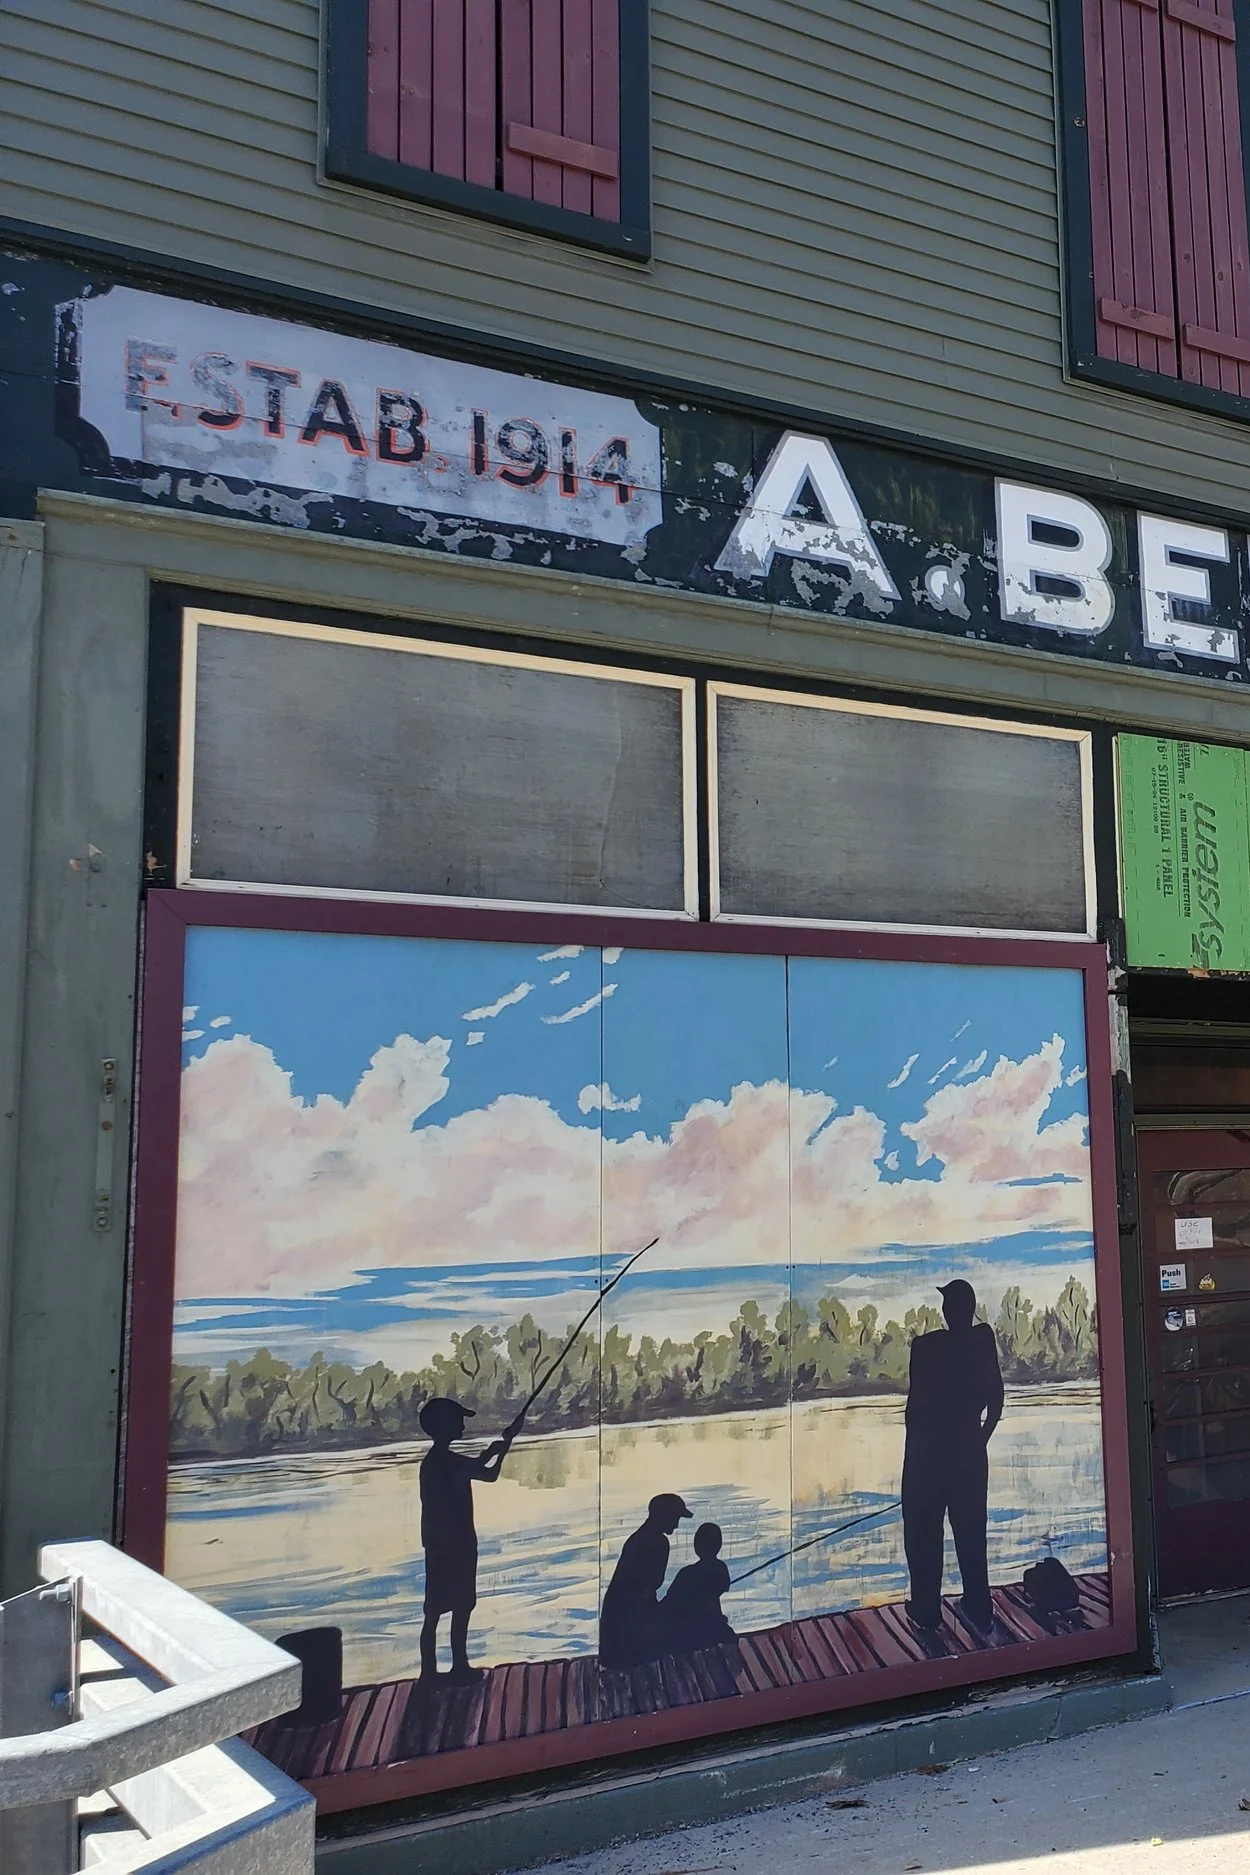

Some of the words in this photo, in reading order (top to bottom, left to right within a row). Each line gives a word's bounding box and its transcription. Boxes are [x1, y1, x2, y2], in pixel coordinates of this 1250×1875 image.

[471, 407, 635, 505] 1914
[1158, 764, 1172, 842] STRUCTURAL
[1161, 858, 1174, 898] PANEL
[1162, 1268, 1181, 1277] Push
